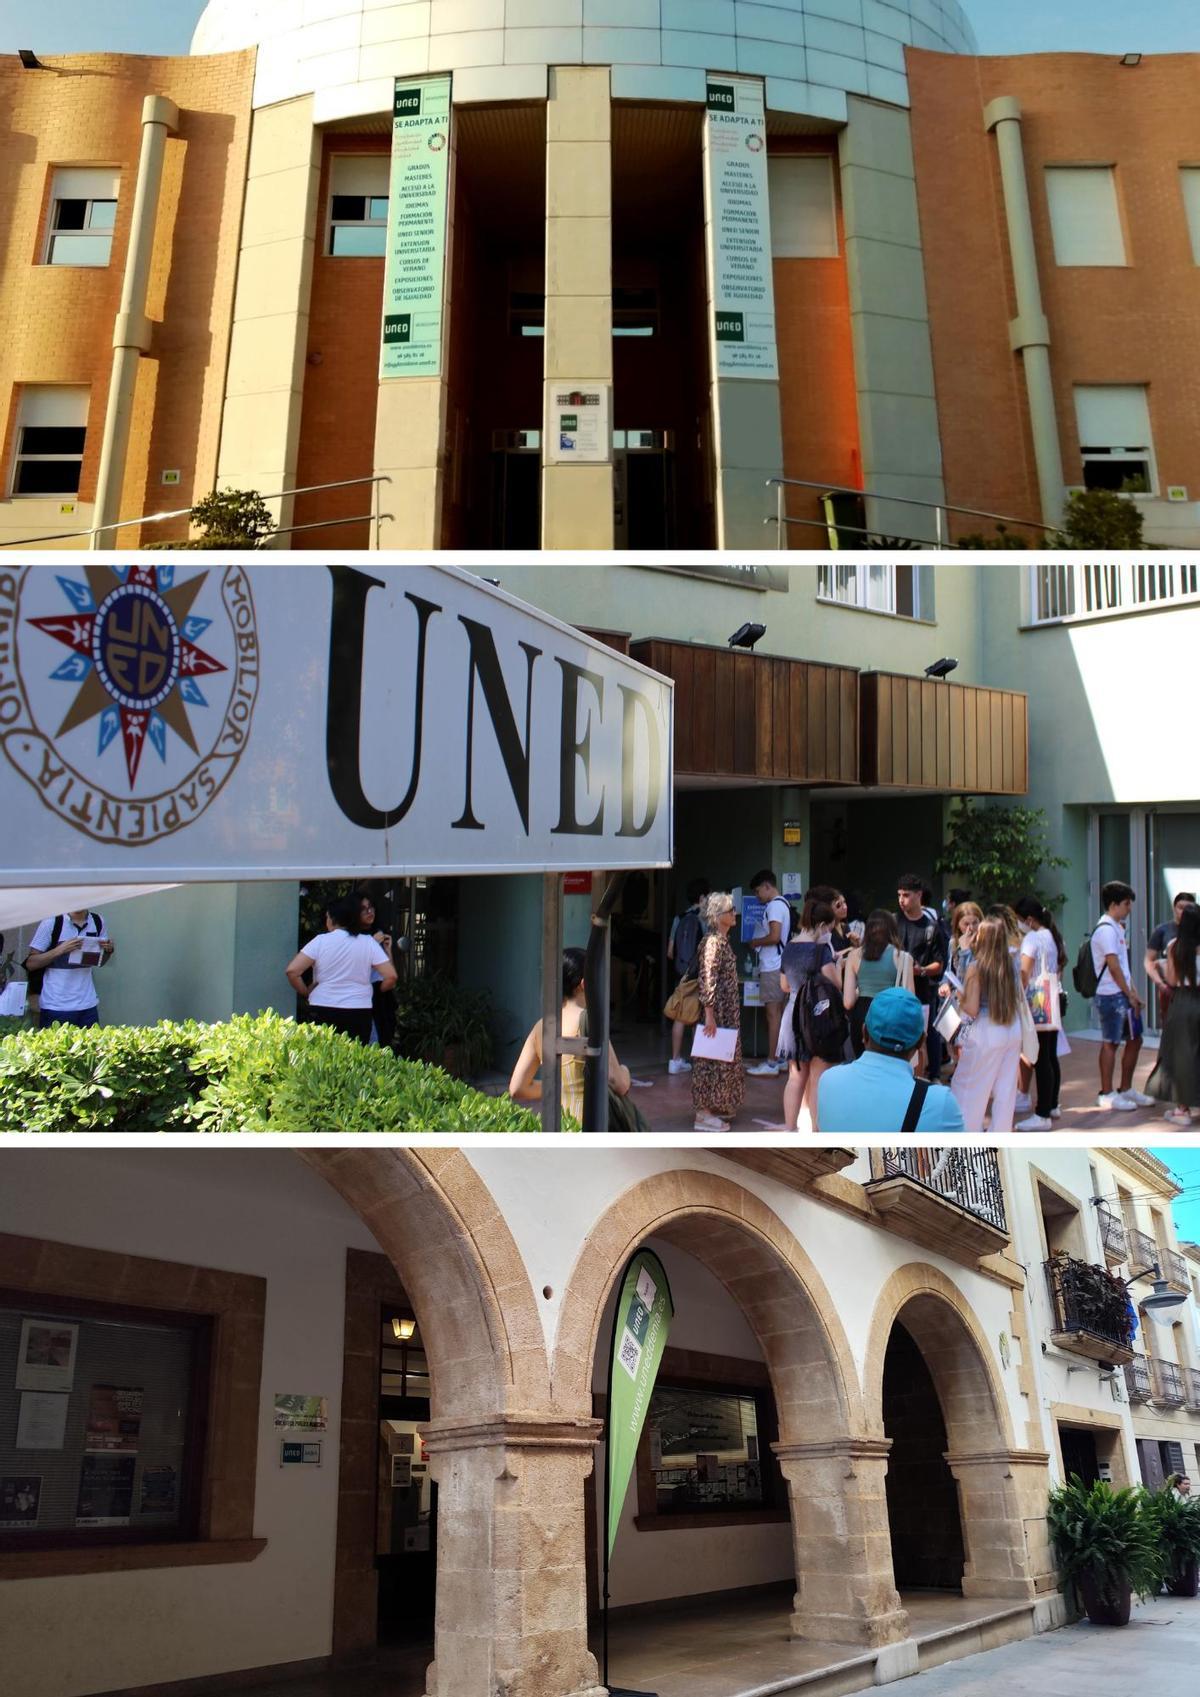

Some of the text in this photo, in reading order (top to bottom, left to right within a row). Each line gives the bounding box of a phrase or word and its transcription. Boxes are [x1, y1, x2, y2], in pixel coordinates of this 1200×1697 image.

[396, 97, 418, 108] UNED
[709, 93, 732, 104] UNED
[404, 118, 433, 127] ADAPTA
[709, 114, 718, 122] SE
[719, 115, 749, 125] ADAPTA
[407, 163, 430, 171] GRADOS
[398, 190, 436, 198] UNIVERSIDAD
[720, 188, 758, 196] UNIVERSIDAD
[721, 215, 758, 224] PERMANENTE
[394, 246, 435, 255] UNIVERSITARIA
[720, 244, 763, 252] UNIVERSITARIA
[394, 275, 433, 284] EXPOSICIONES
[722, 273, 763, 281] EXPOSICIONES
[392, 286, 435, 294] OBSERVATORIO
[721, 284, 766, 293] OBSERVATORIO
[385, 323, 408, 334] UNED
[716, 321, 741, 331] UNED
[222, 575, 256, 747] MOBILIOR
[326, 565, 665, 837] UNED
[37, 748, 216, 840] SAPIENTIA
[633, 1306, 644, 1335] UNED
[629, 1297, 666, 1433] www.uneddenia.es
[284, 1449, 301, 1457] UNED
